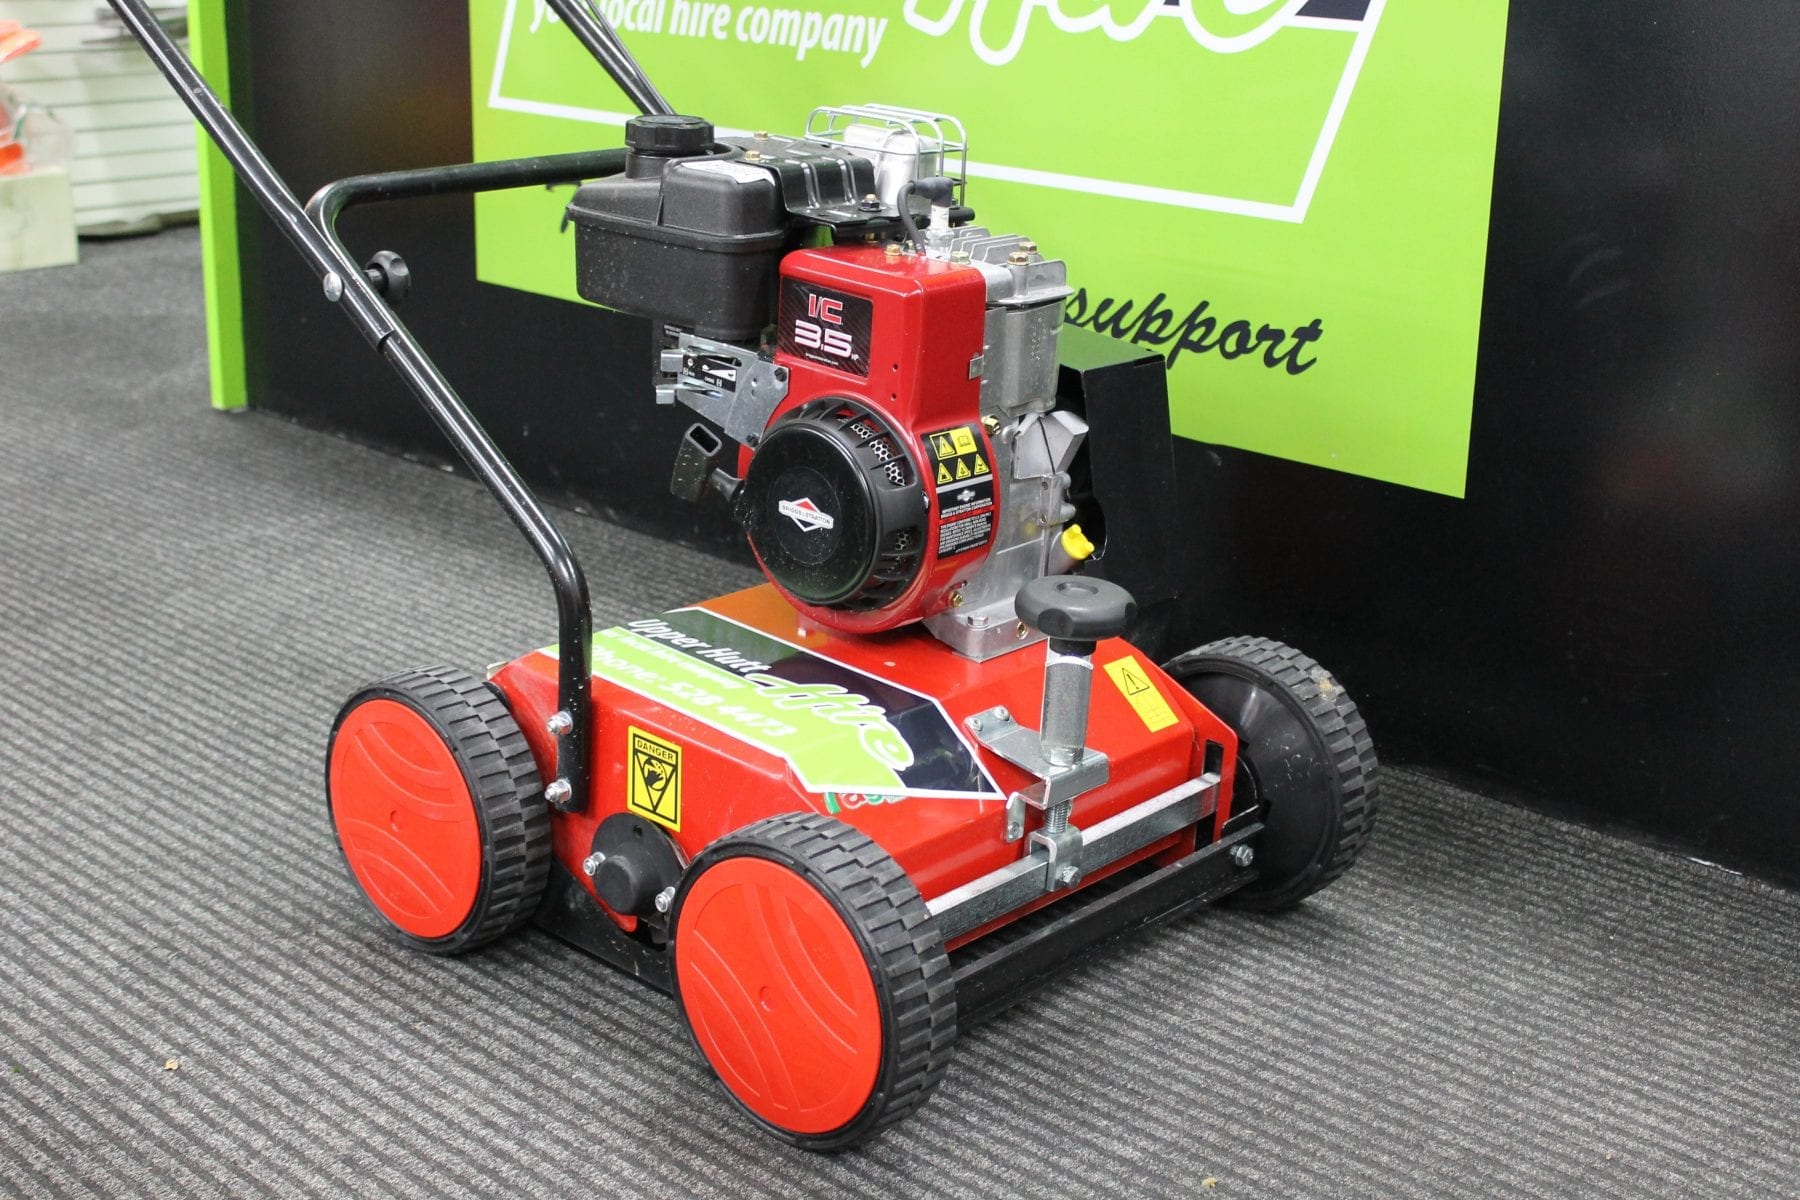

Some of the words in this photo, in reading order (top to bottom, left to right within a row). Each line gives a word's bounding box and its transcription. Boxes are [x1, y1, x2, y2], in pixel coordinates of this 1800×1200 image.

[669, 0, 731, 40] hire
[735, 3, 889, 69] company
[794, 319, 852, 358] 3.5
[1065, 287, 1324, 376] support
[627, 618, 713, 650] Upper
[695, 647, 772, 673] Hutt
[636, 739, 674, 761] DANGER
